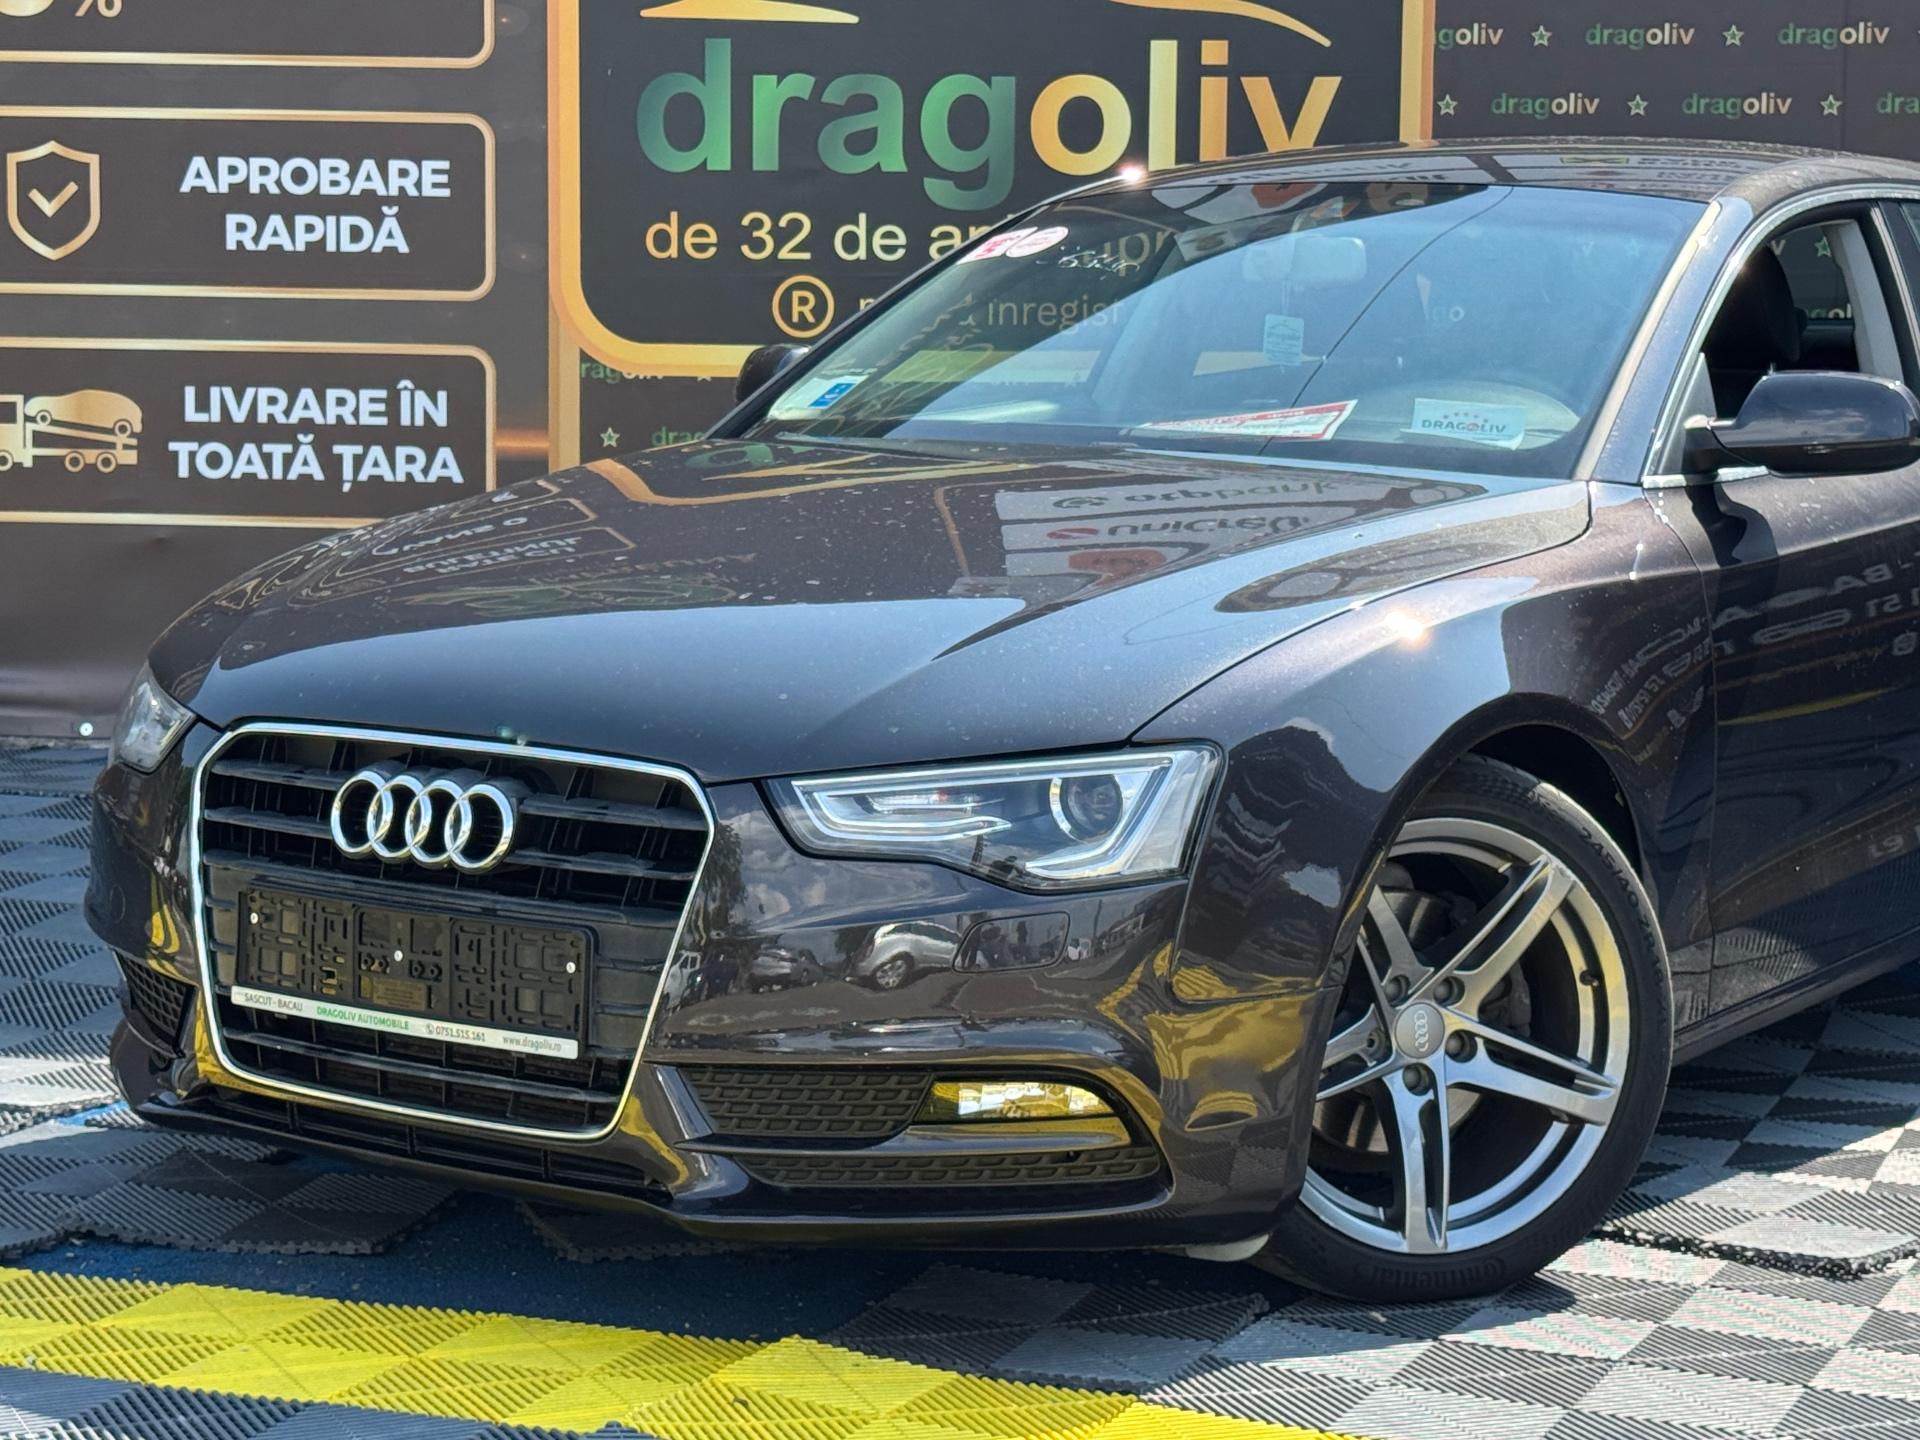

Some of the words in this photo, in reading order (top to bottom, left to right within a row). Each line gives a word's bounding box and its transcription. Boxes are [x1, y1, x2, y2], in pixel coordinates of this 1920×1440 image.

[1434, 22, 1504, 51] goliv
[1584, 22, 1696, 51] dragoliv
[1777, 21, 1890, 50] dragoliv
[636, 38, 1342, 211] dragoliv
[1490, 92, 1600, 120] dragoliv
[1681, 91, 1792, 120] dragoliv
[180, 155, 452, 198] APROBARE
[224, 205, 411, 254] RAPIDĂ
[645, 212, 718, 261] de
[740, 212, 813, 262] 32
[833, 212, 907, 262] de
[184, 385, 389, 427] LIVRARE
[396, 379, 448, 428] ÎN
[1421, 419, 1507, 434] DRAGOLIV
[168, 433, 326, 483] TOATĂ
[332, 443, 465, 494] ȚARA
[244, 992, 273, 1006] SASCUT
[316, 1005, 358, 1021] DRAGOLIV
[357, 1013, 410, 1031] AUTOMOBILE
[502, 1034, 562, 1053] www.dragoliv.ro
